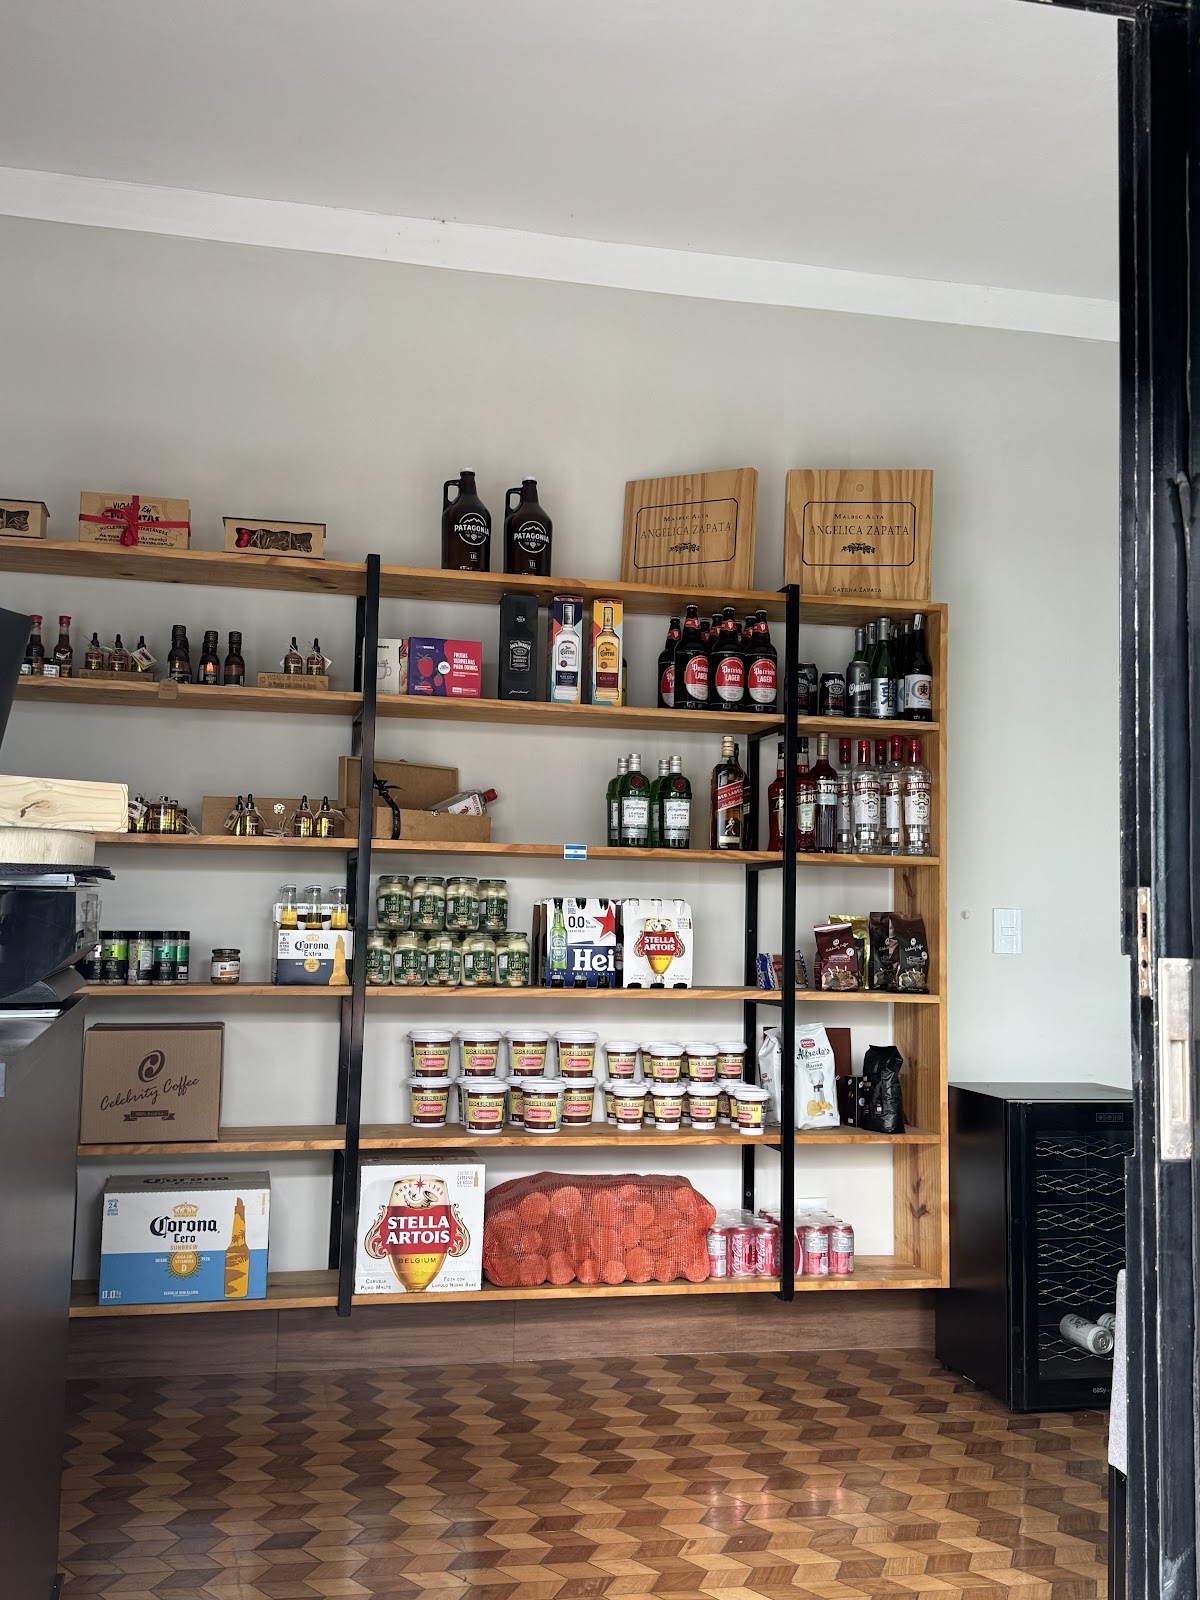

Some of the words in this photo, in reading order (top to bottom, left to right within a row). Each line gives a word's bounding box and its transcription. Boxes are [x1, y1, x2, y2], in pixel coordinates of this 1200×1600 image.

[663, 514, 690, 522] MALBEC
[454, 524, 490, 536] PATAGONIA
[640, 526, 689, 540] ANGELICA
[692, 521, 732, 535] ZAPATA
[808, 525, 863, 535] ANGELICA
[867, 525, 910, 536] ZAPATA
[513, 532, 550, 544] PATAGONIA
[724, 673, 741, 682] LAGER
[756, 675, 773, 683] LAGER
[728, 788, 743, 797] LABEL
[568, 916, 585, 929] 0.0
[294, 940, 330, 952] Corona
[303, 949, 322, 957] Extra
[796, 1047, 831, 1060] Alfredo's
[100, 1086, 161, 1111] Celebrity
[163, 1075, 200, 1097] Coffee
[142, 1175, 229, 1184] Corona
[149, 1215, 219, 1238] Corona
[387, 1215, 450, 1229] STELLA
[173, 1233, 196, 1244] Cero
[386, 1230, 451, 1245] ARTOIS
[181, 1264, 187, 1272] D
